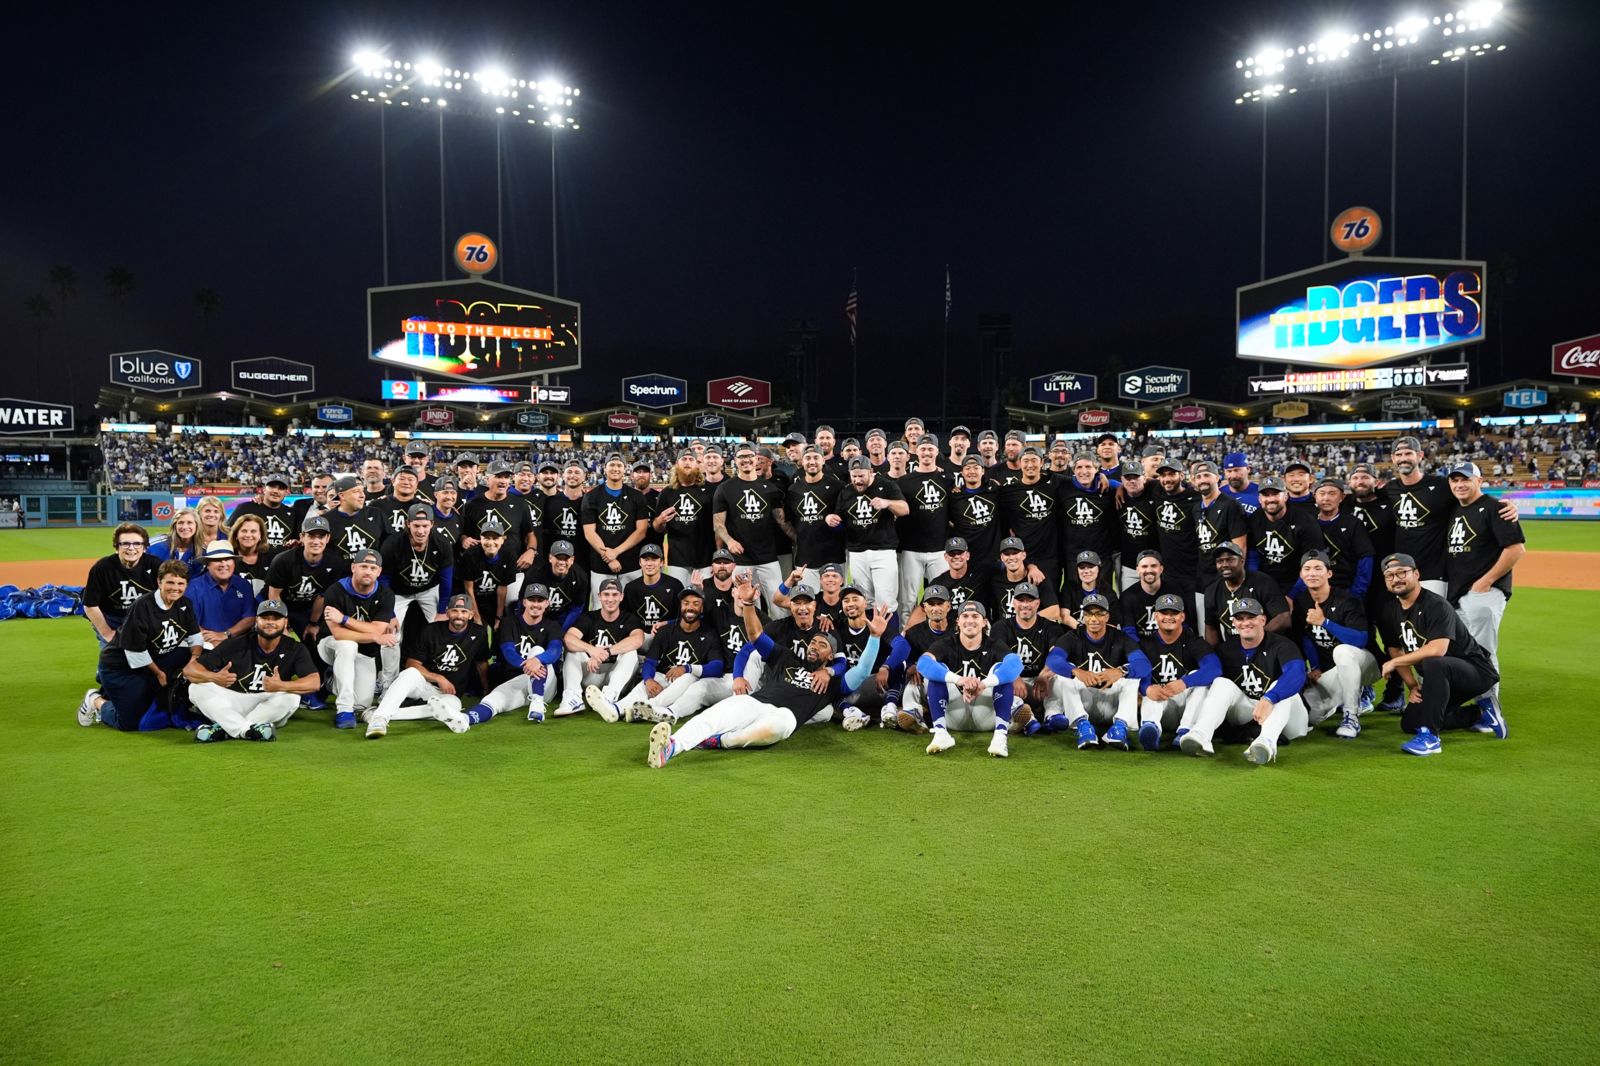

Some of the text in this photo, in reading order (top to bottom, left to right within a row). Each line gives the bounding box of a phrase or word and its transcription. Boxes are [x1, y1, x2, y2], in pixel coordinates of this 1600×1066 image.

[1342, 218, 1370, 240] 76
[465, 245, 488, 264] 76
[406, 322, 426, 332] ON
[436, 324, 456, 334] TO
[466, 325, 494, 336] THE
[120, 356, 169, 376] blue
[1561, 346, 1600, 369] Coca
[128, 374, 175, 384] california
[239, 372, 308, 382] GUGGENHEIM
[1044, 382, 1081, 391] ULTRA
[1145, 374, 1182, 384] Security
[630, 384, 677, 396] Spectrum
[1146, 384, 1177, 394] Benefit
[1509, 392, 1542, 405] TEL
[427, 411, 448, 420] JINRO
[1080, 413, 1108, 422] Churu
[744, 490, 760, 512] LA
[922, 481, 940, 503] LA
[1027, 490, 1047, 513] LA
[156, 506, 170, 516] 76
[606, 503, 621, 524] LA
[679, 494, 694, 514] LA
[802, 493, 818, 515] LA
[856, 496, 872, 518] LA
[968, 497, 990, 519] LA
[1075, 498, 1093, 520] LA
[1161, 501, 1177, 523] LA
[1398, 493, 1418, 522] LA
[267, 516, 284, 538] LA
[392, 510, 405, 532] LA
[561, 507, 577, 529] LA
[1126, 507, 1142, 530] LA
[345, 527, 366, 551] LA
[1450, 517, 1465, 545] LA
[1265, 531, 1284, 556] LA
[410, 560, 429, 581] LA
[479, 571, 496, 590] LA
[120, 581, 142, 604] LA
[236, 590, 244, 598] LA
[644, 597, 660, 619] LA
[162, 620, 179, 647] LA
[727, 625, 742, 651] LA
[1400, 622, 1419, 651] LA
[441, 645, 459, 666] LA
[676, 641, 691, 666] LA
[1016, 638, 1032, 663] LA
[1159, 655, 1177, 682] LA
[1241, 665, 1262, 692] LA
